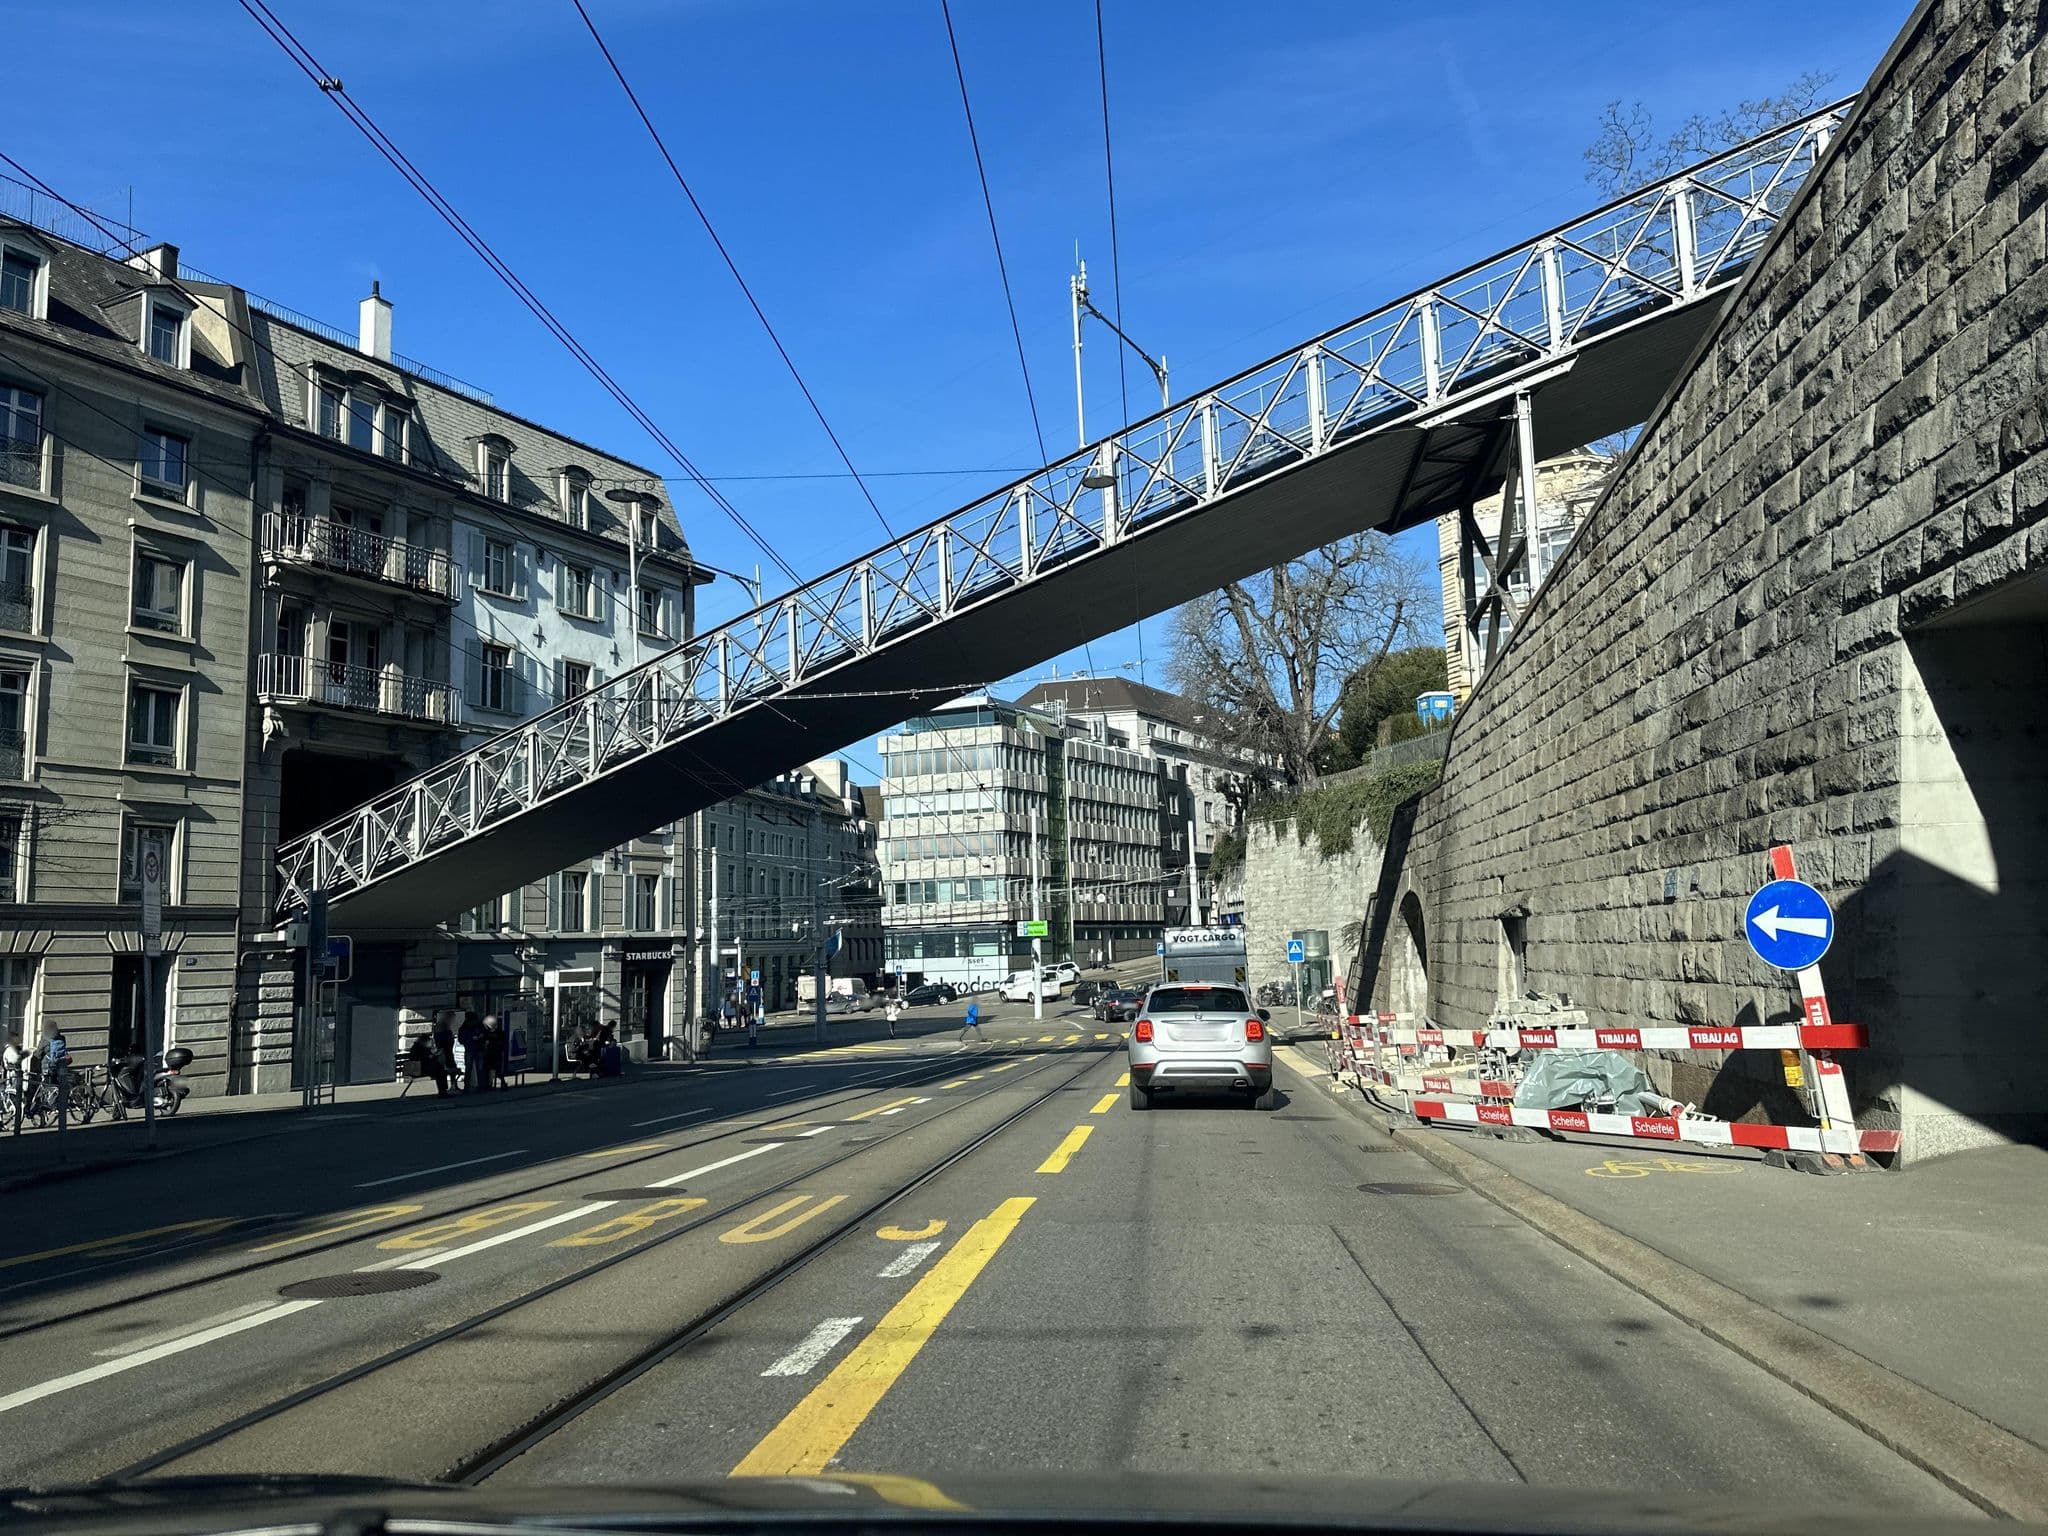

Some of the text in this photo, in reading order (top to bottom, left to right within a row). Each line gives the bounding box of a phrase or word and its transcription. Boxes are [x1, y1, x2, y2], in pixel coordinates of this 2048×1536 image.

[1173, 933, 1236, 943] VOGT.CARGO
[625, 951, 672, 961] STARBUCKS
[1809, 1001, 1824, 1026] TIB
[1521, 1034, 1555, 1044] TIBAU AG
[1599, 1034, 1638, 1044] TIBAU AG
[1692, 1033, 1738, 1043] TIBAU AG
[1552, 1115, 1586, 1128] Scheifele
[1635, 1120, 1675, 1135] Scheifele
